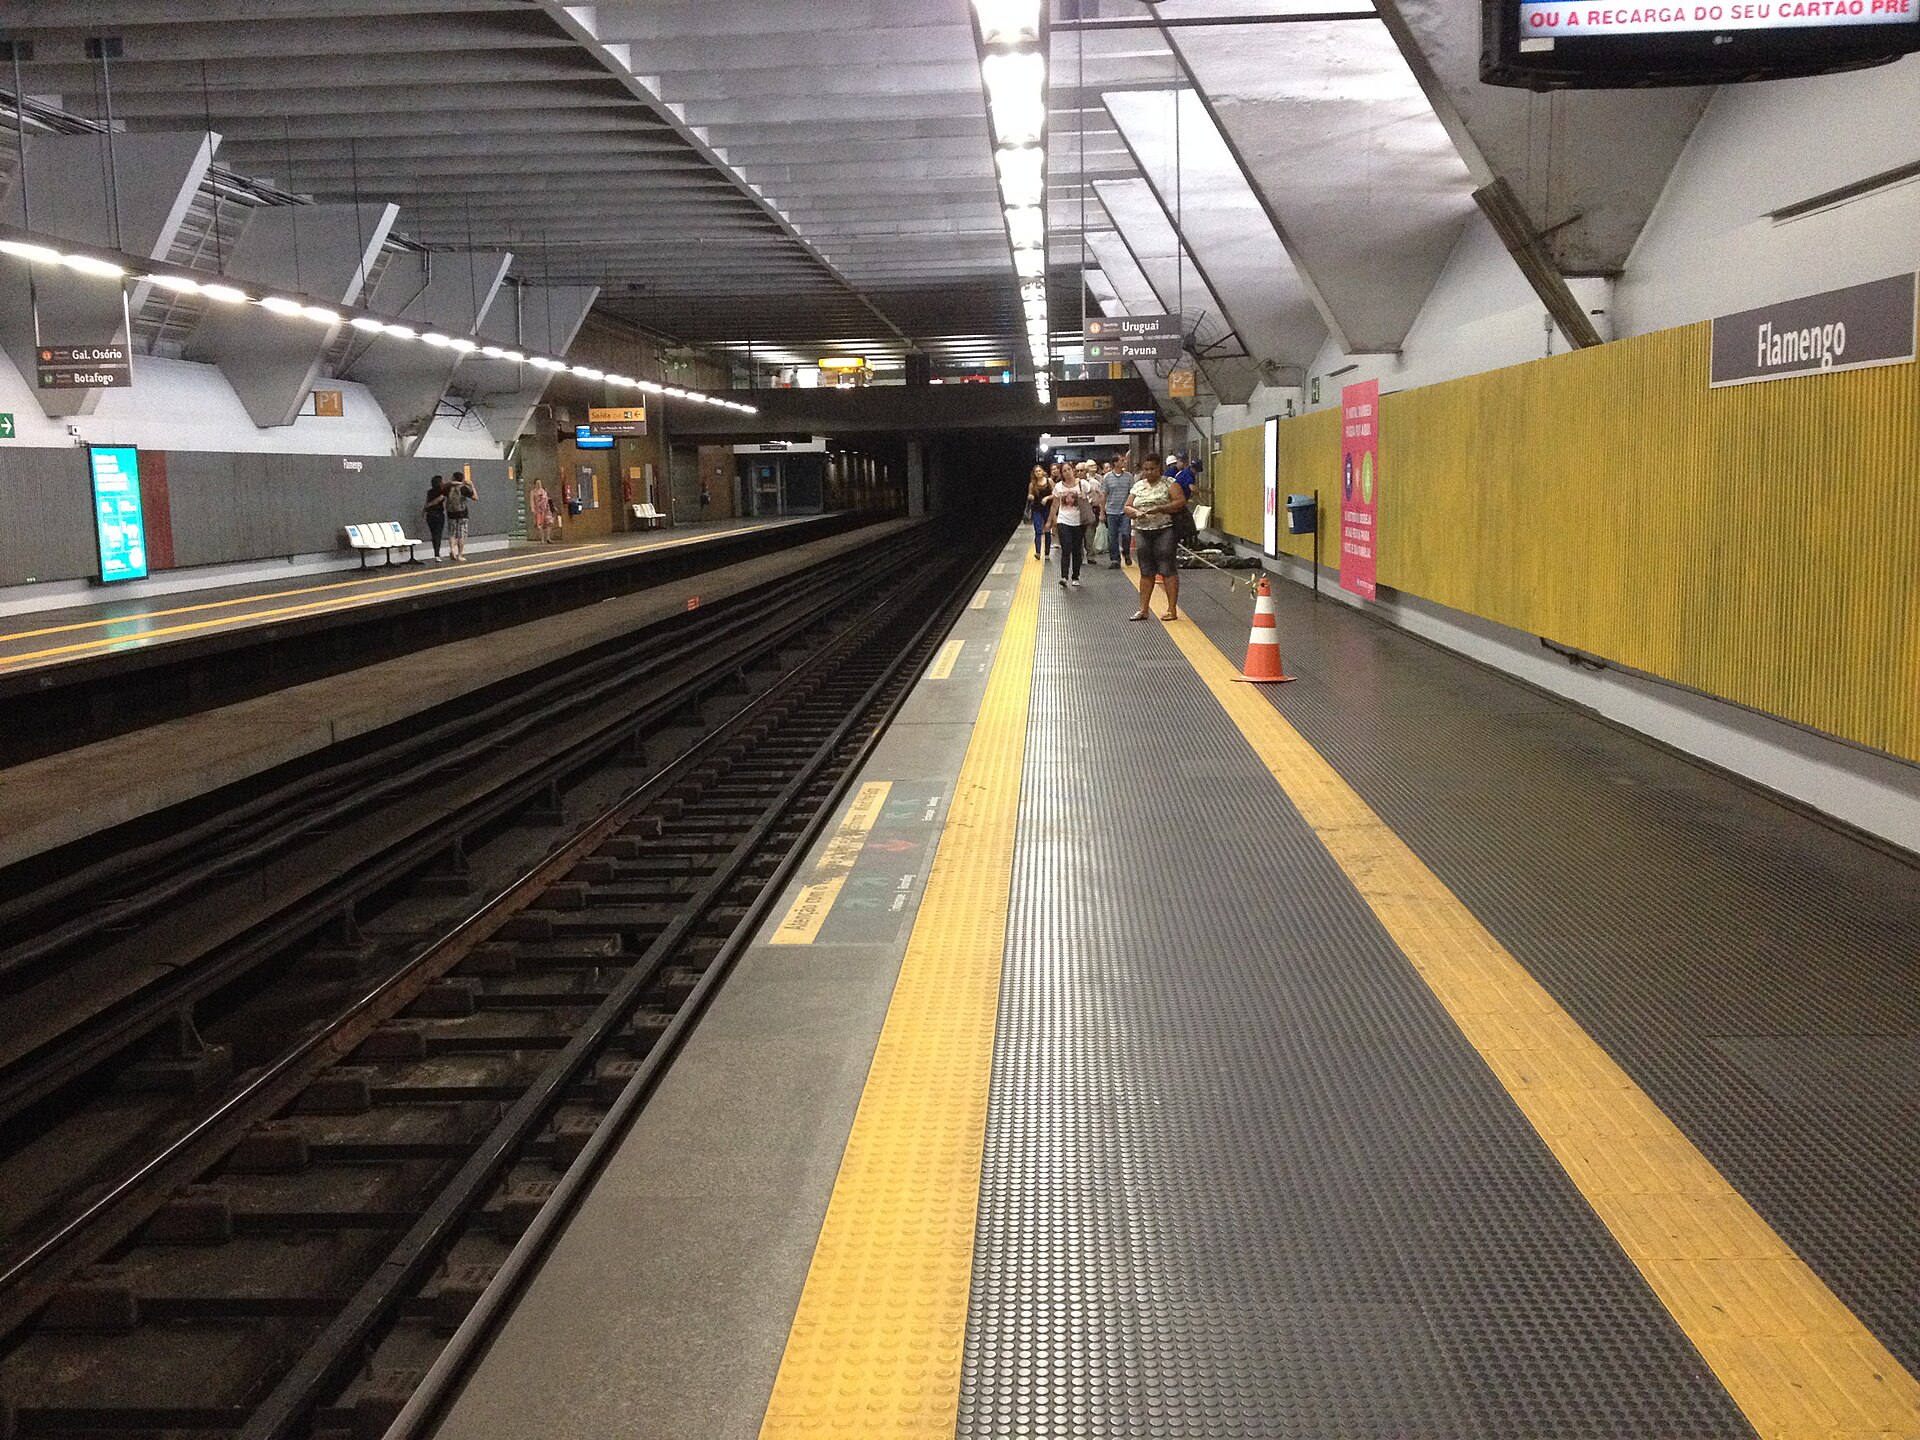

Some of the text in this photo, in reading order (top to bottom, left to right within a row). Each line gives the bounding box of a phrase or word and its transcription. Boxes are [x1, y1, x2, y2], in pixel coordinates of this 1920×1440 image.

[1530, 12, 1559, 27] OU
[1567, 11, 1579, 26] A
[1587, 7, 1685, 25] RECARGA
[1694, 6, 1723, 20] DO
[1731, 4, 1770, 19] SEU
[1122, 320, 1159, 333] Uruguai
[1122, 345, 1157, 355] Pavuna
[1758, 321, 1846, 370] Flamengo
[72, 349, 91, 359] Gal.
[92, 348, 122, 359] Osório
[74, 372, 114, 385] Botafogo
[320, 392, 338, 409] P1
